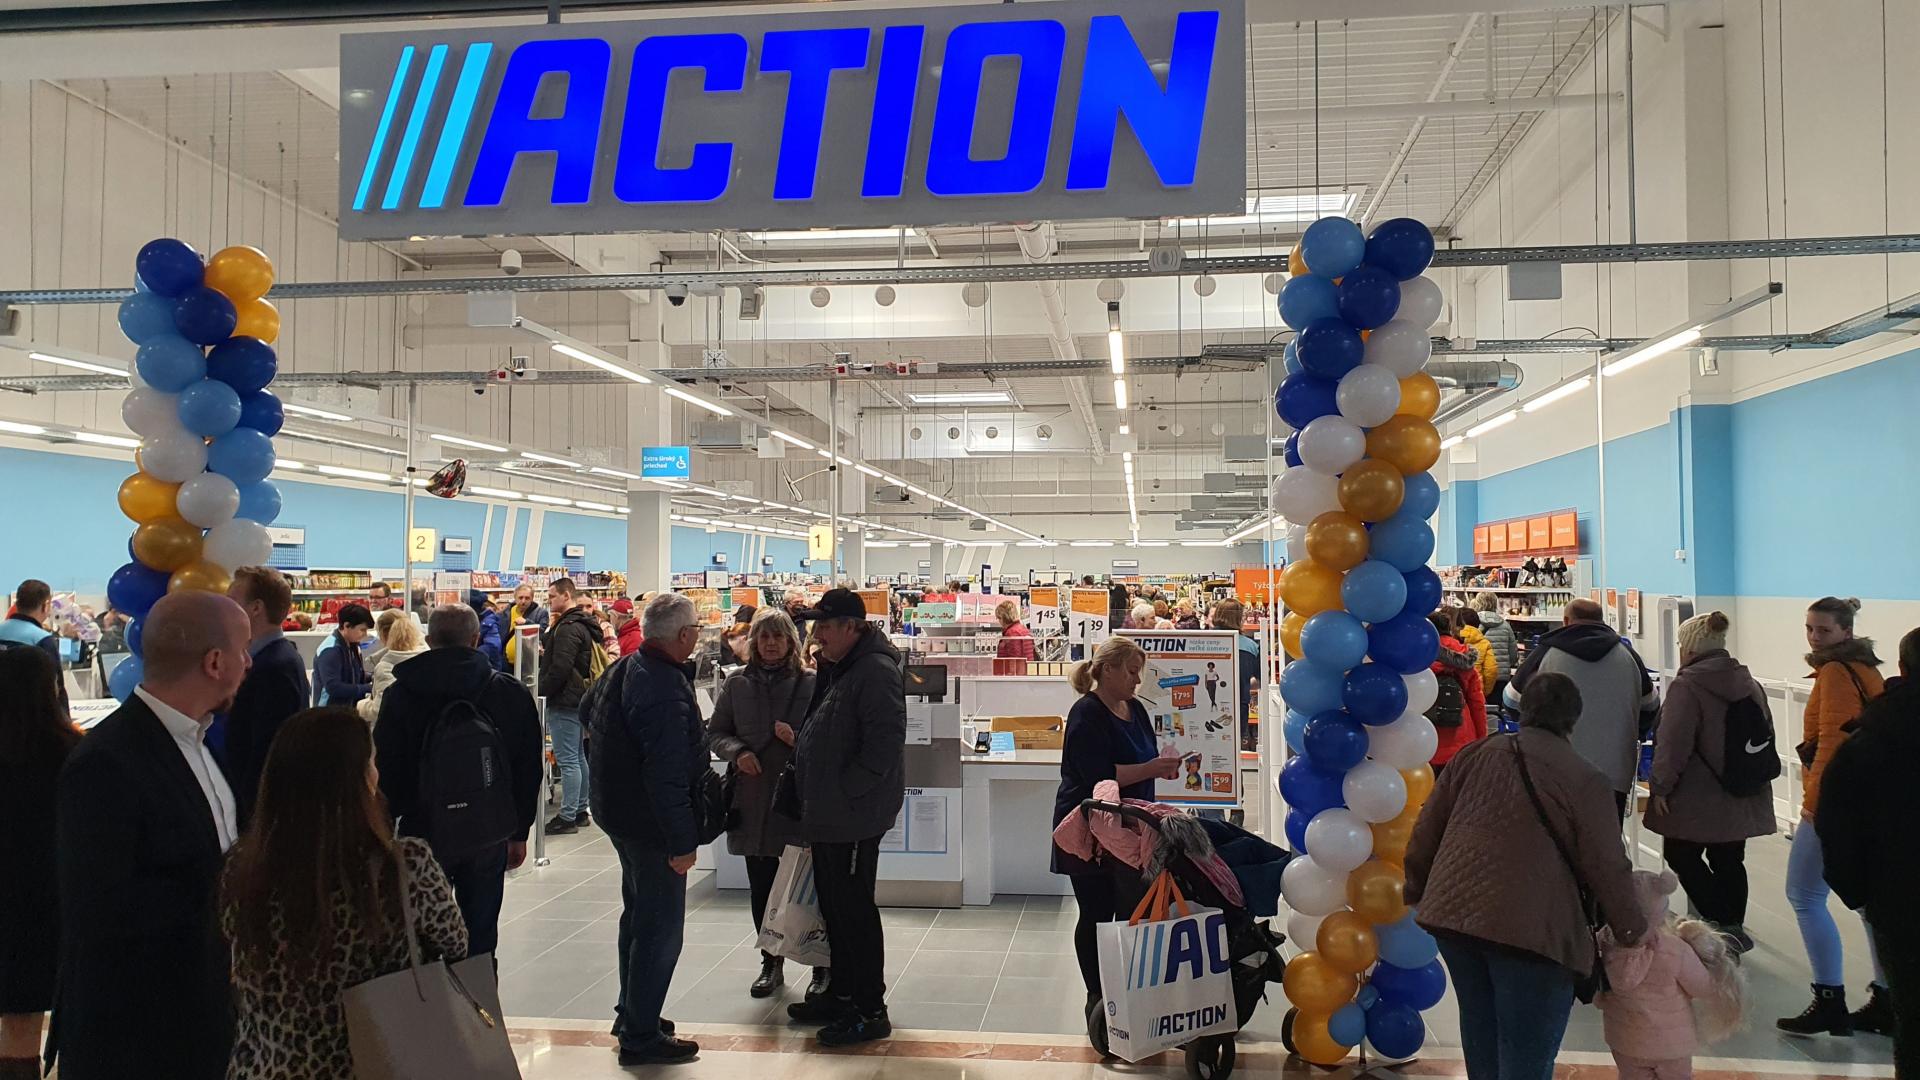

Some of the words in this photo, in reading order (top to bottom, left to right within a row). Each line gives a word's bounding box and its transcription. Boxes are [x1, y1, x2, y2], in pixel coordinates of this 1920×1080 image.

[462, 9, 1221, 207] ACTION
[416, 535, 426, 550] 2
[904, 788, 923, 796] CTION
[1158, 1003, 1227, 1037] ACTION
